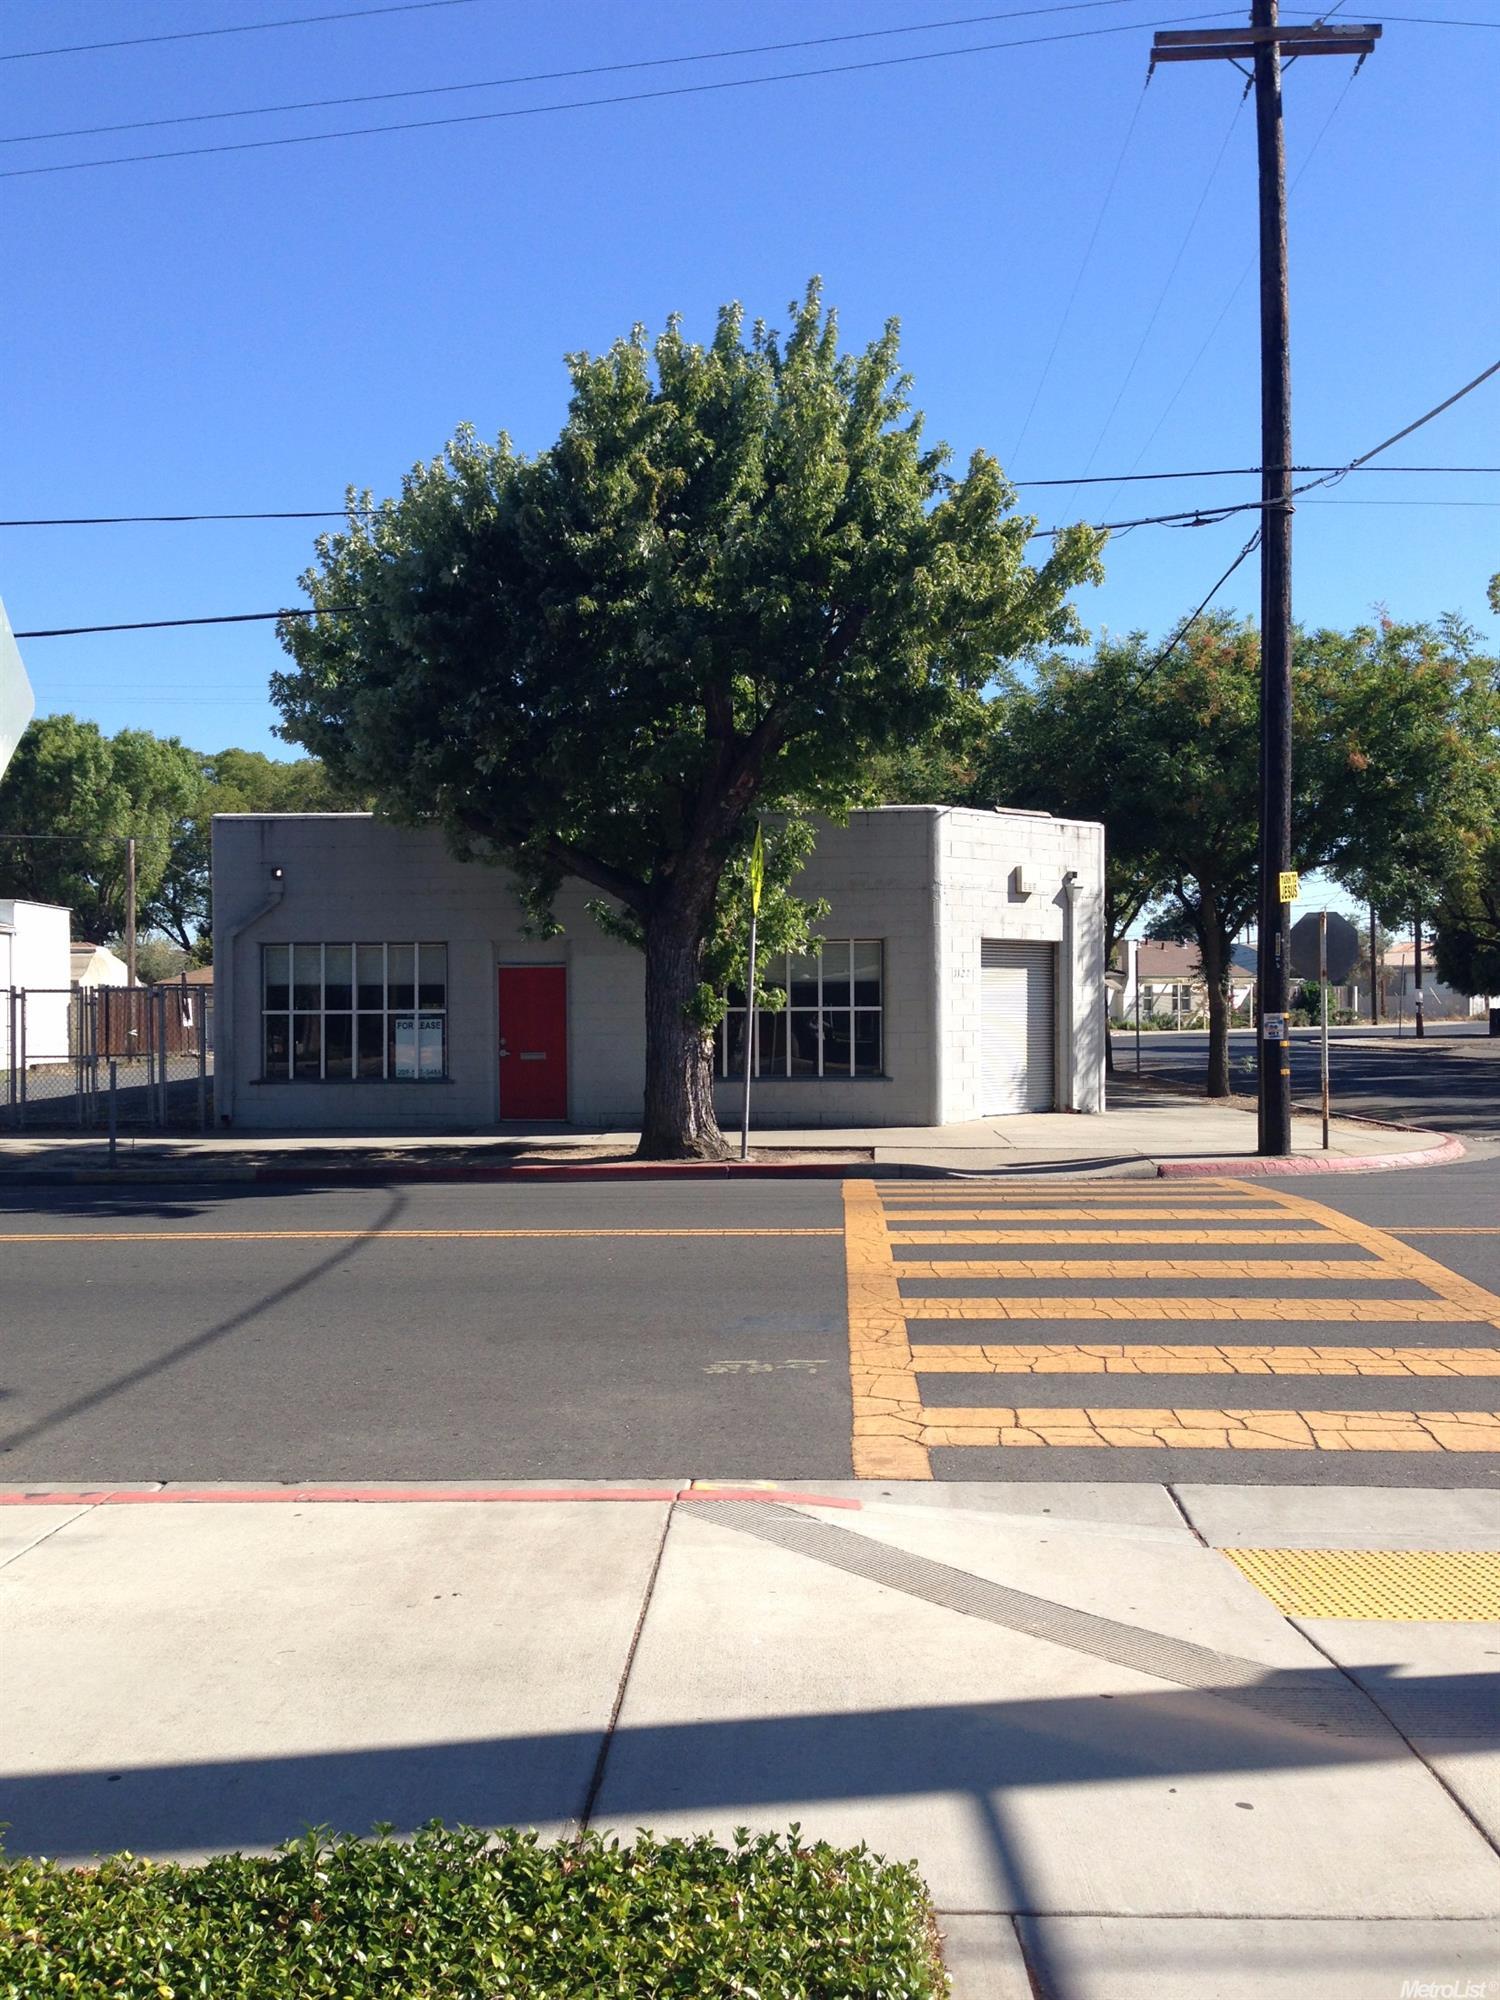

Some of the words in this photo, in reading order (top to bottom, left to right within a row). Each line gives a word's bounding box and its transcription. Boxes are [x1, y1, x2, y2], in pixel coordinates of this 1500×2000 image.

[1281, 875, 1291, 885] TURN
[1281, 884, 1297, 899] JESUS
[397, 1021, 414, 1030] FOR
[418, 1020, 441, 1030] EASE
